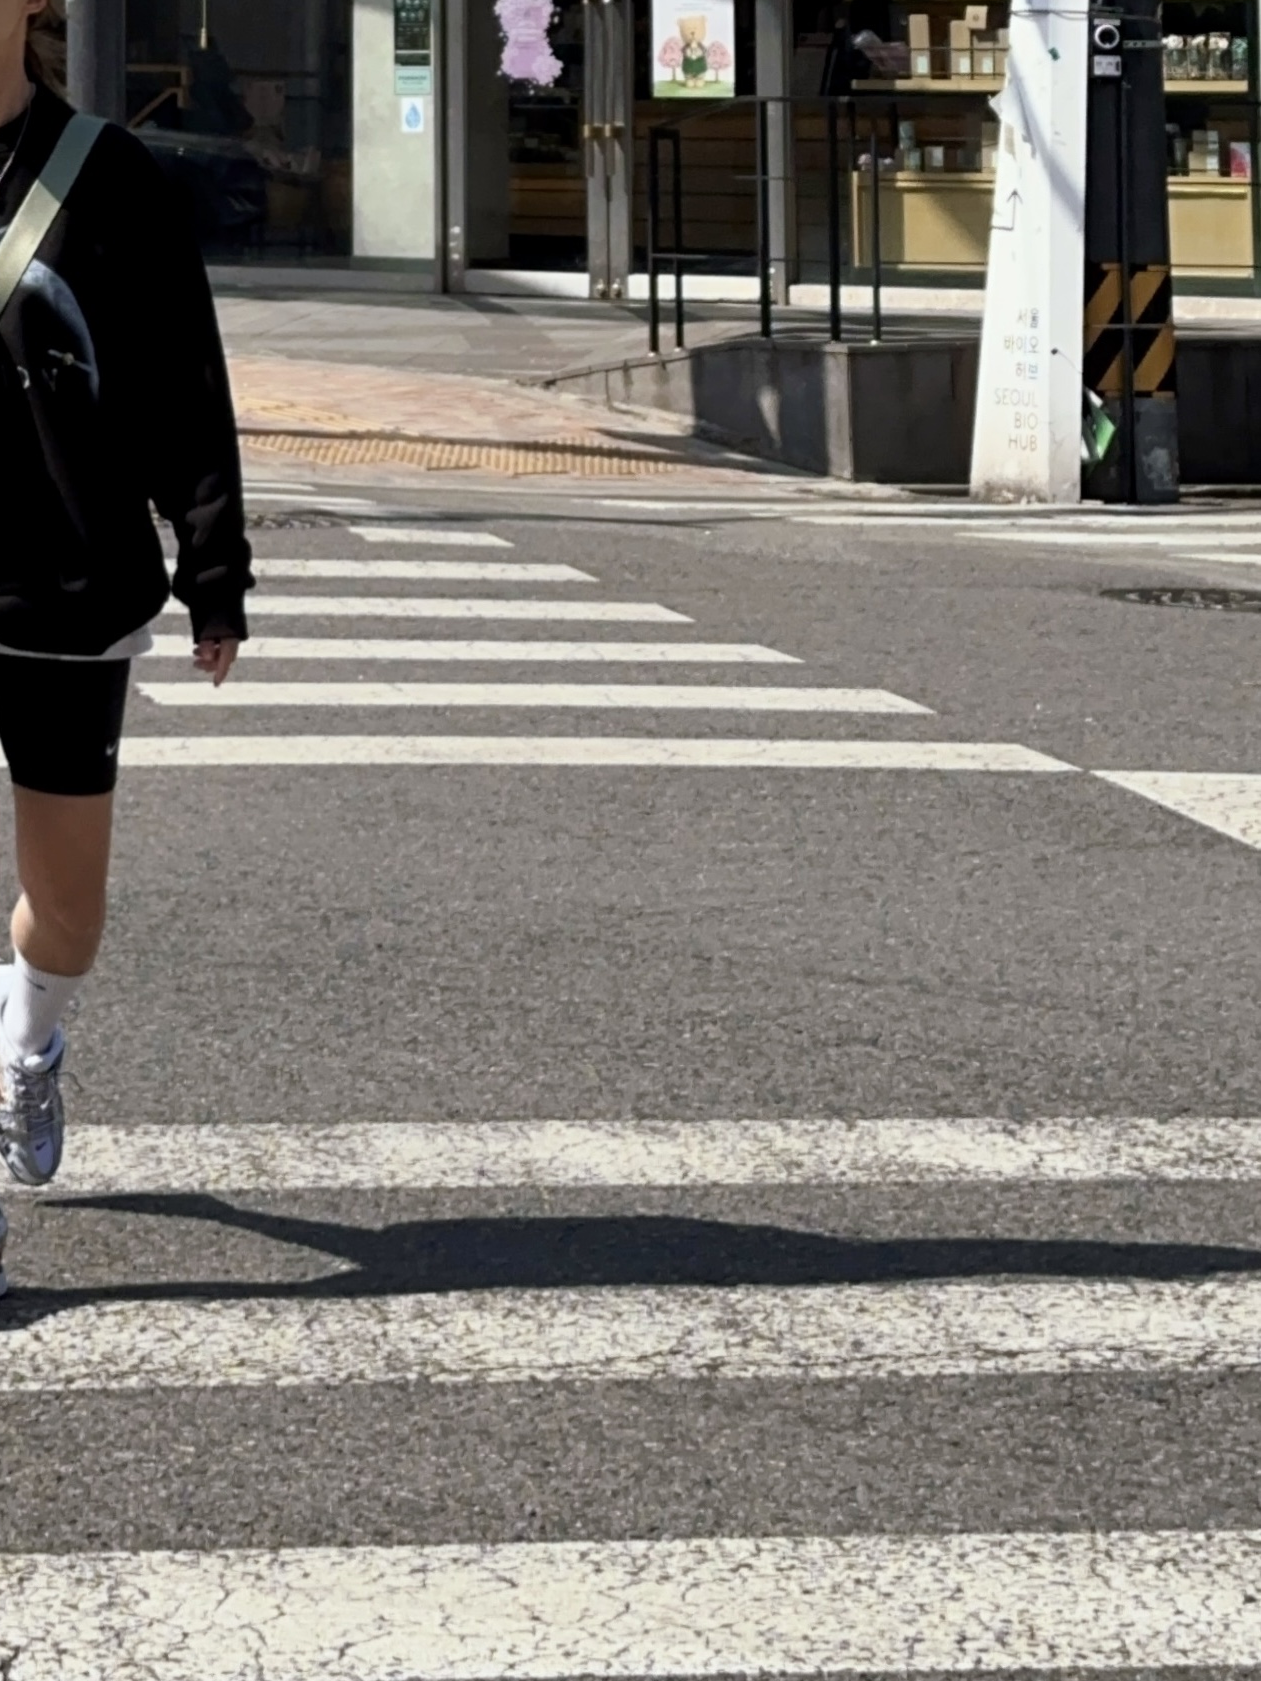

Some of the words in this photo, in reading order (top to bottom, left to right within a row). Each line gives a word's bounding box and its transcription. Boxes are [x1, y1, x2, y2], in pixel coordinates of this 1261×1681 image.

[1004, 336, 1039, 354] 바이오
[1016, 362, 1039, 380] 허브
[994, 387, 1039, 408] SEOUL
[1014, 412, 1039, 430] BIO
[1008, 435, 1038, 452] HUB
